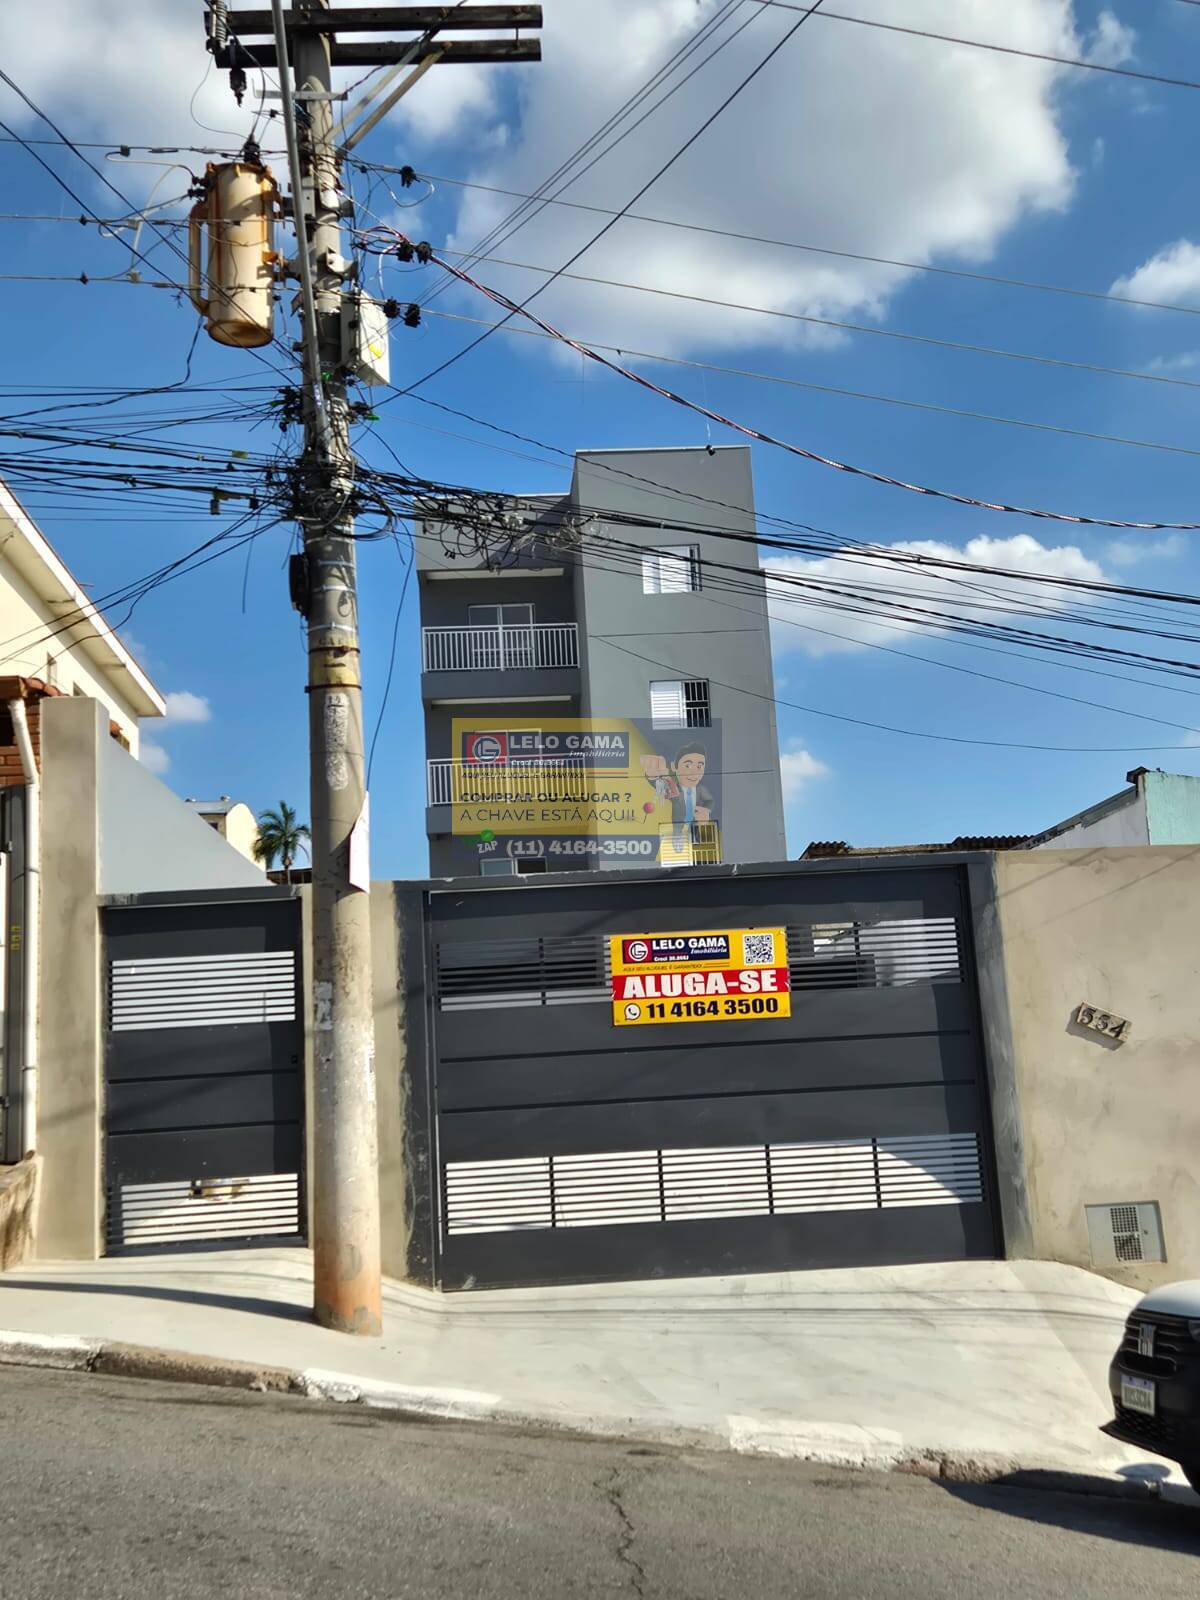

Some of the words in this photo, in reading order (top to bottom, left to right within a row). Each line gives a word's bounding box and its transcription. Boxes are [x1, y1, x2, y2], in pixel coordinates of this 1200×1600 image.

[652, 940, 685, 951] LELO
[688, 937, 727, 949] GAMA
[623, 970, 778, 999] ALUGA-SE
[646, 1003, 665, 1019] 11
[670, 1001, 719, 1017] 4164
[724, 997, 778, 1014] 3500
[1080, 1007, 1127, 1038] 534
